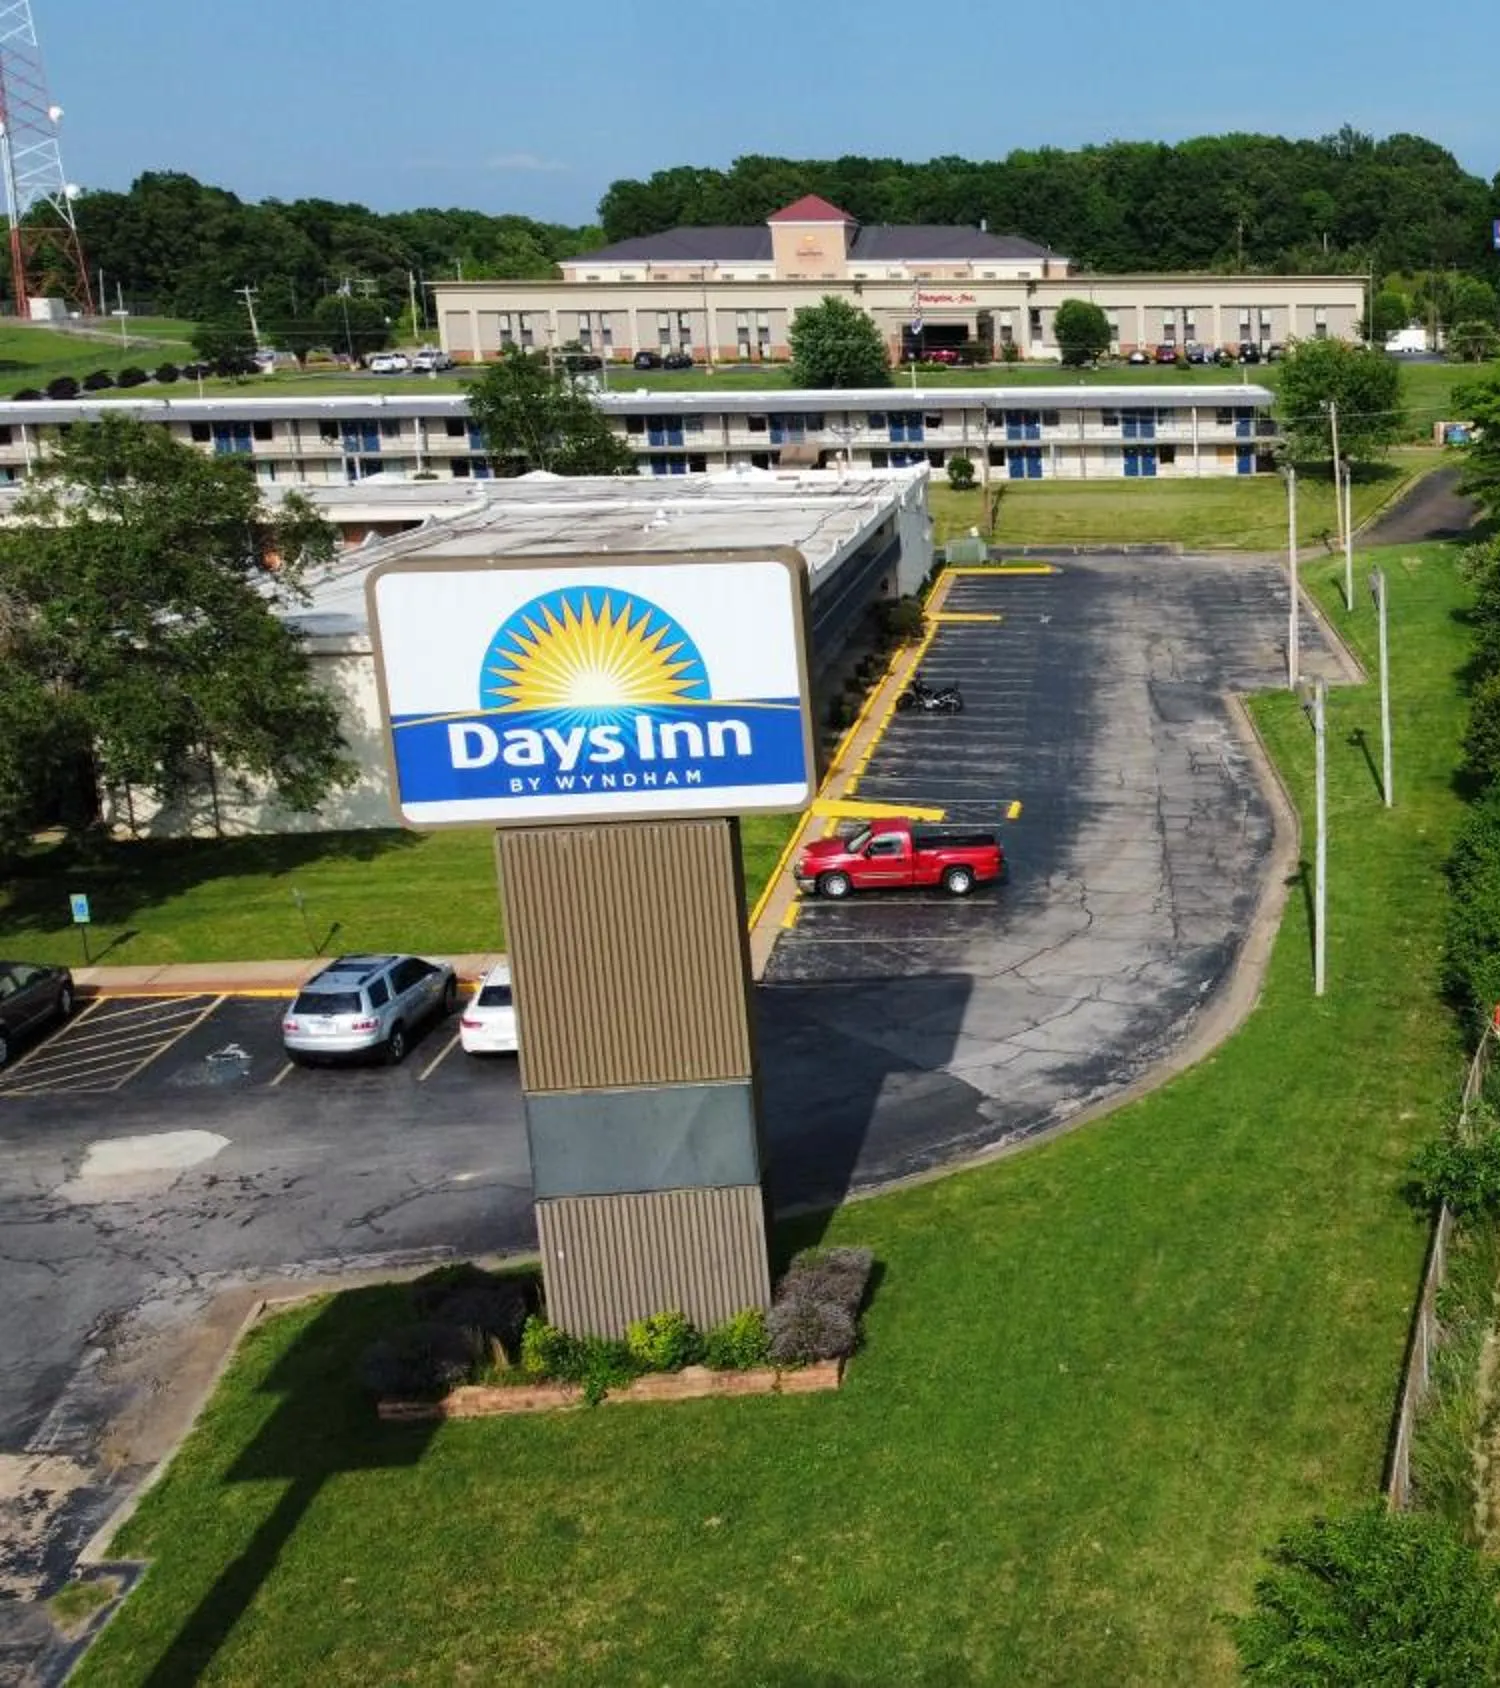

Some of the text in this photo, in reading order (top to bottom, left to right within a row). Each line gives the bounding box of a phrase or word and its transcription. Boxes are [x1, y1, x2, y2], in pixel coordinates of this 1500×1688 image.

[448, 716, 753, 770] Days Inn
[510, 769, 704, 793] BY WYNDHAM
